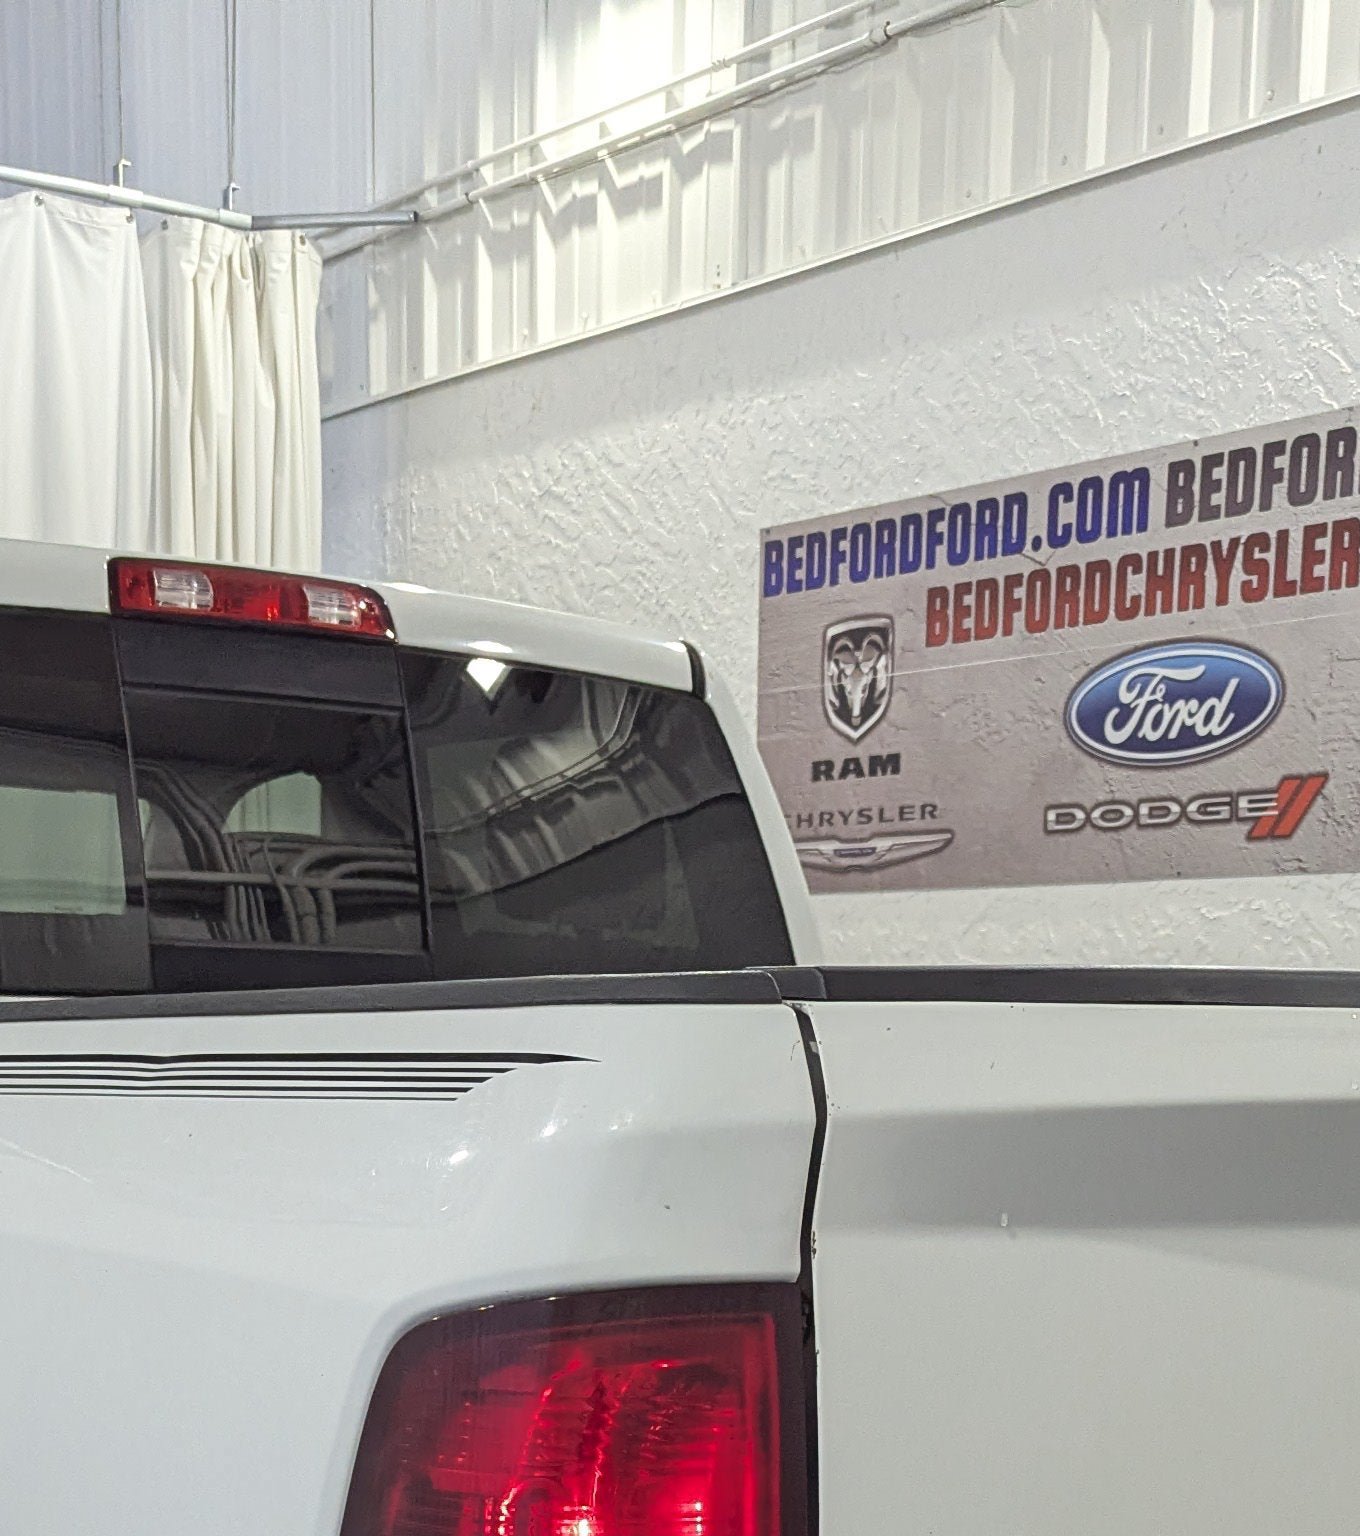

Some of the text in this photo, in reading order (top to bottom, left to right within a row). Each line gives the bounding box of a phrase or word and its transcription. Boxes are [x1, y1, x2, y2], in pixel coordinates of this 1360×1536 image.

[762, 465, 1151, 599] BEDFORDFORD.COM
[1103, 664, 1240, 745] Ford
[810, 752, 902, 783] RAM
[1043, 789, 1280, 835] DODGE
